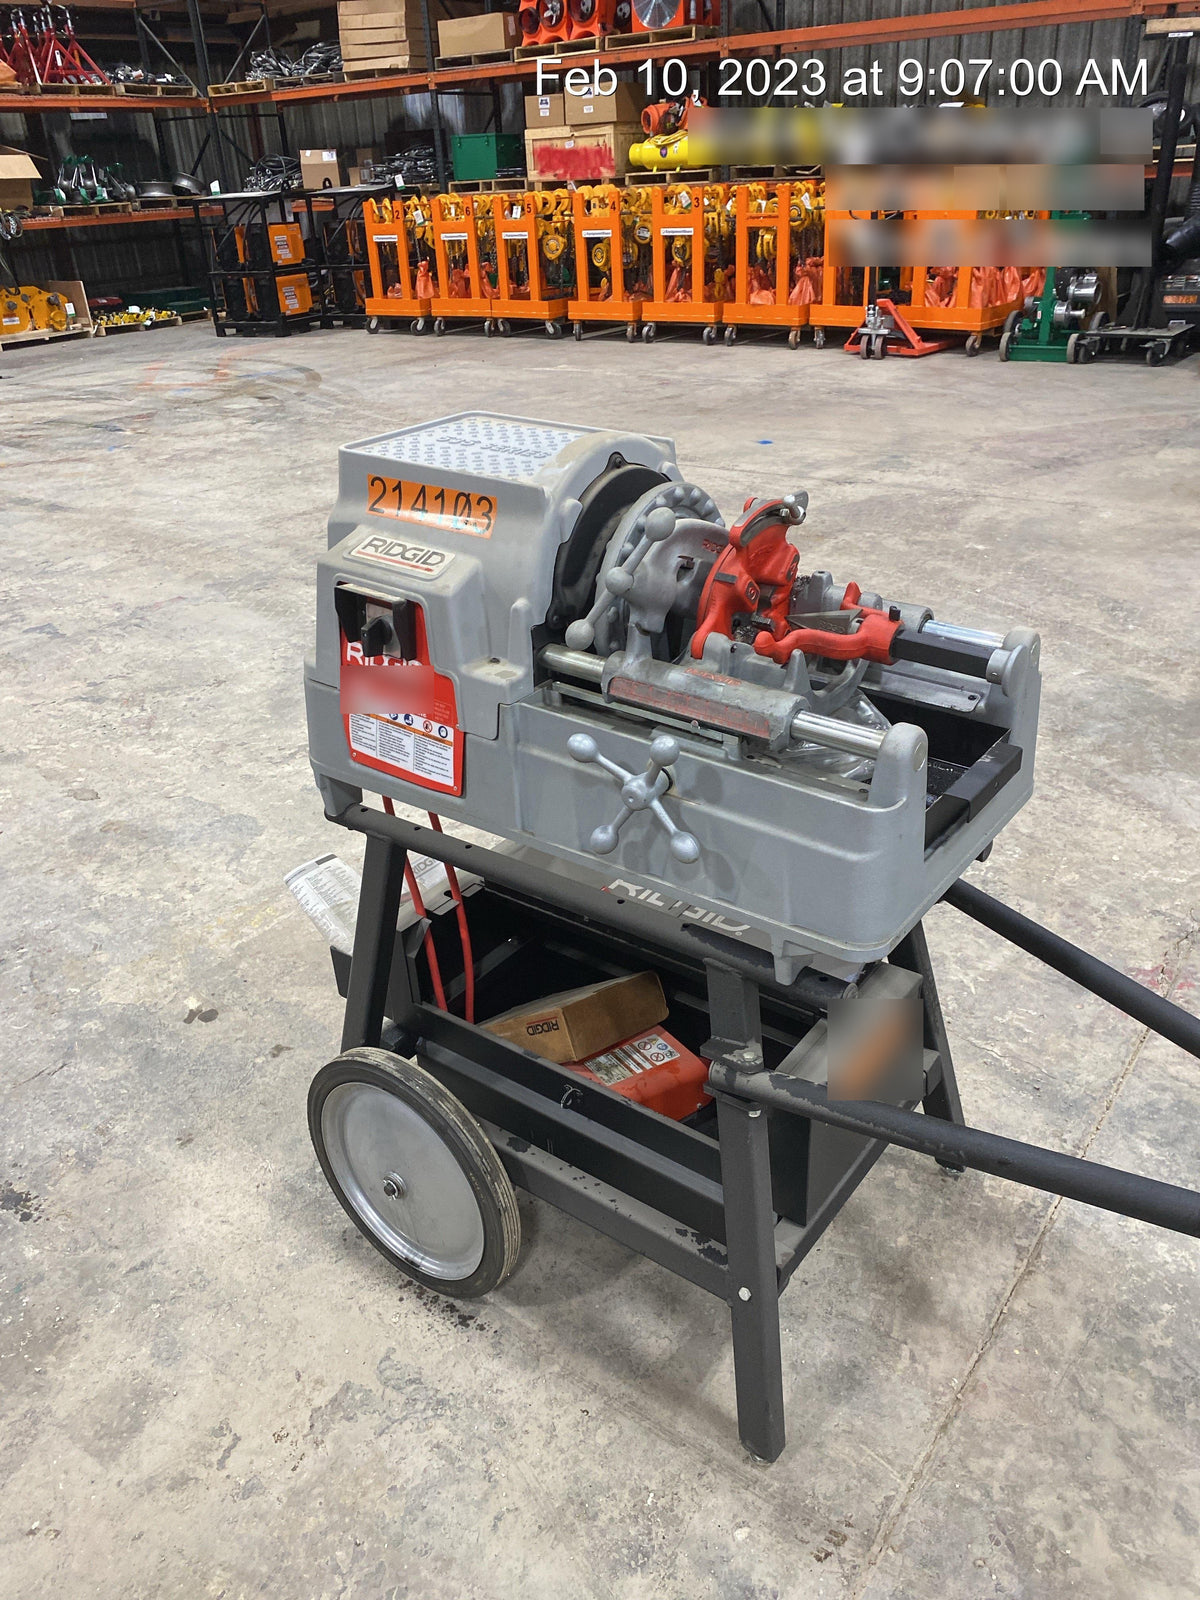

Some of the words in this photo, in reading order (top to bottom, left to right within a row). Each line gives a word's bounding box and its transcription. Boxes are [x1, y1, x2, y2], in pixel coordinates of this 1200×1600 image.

[526, 203, 531, 213] 5
[610, 201, 616, 211] 4
[694, 197, 700, 208] 3
[465, 206, 470, 216] 6
[480, 443, 552, 459] SERIES
[368, 476, 493, 535] 214103
[361, 536, 446, 567] RIDGID
[526, 1019, 560, 1036] RIDGID
